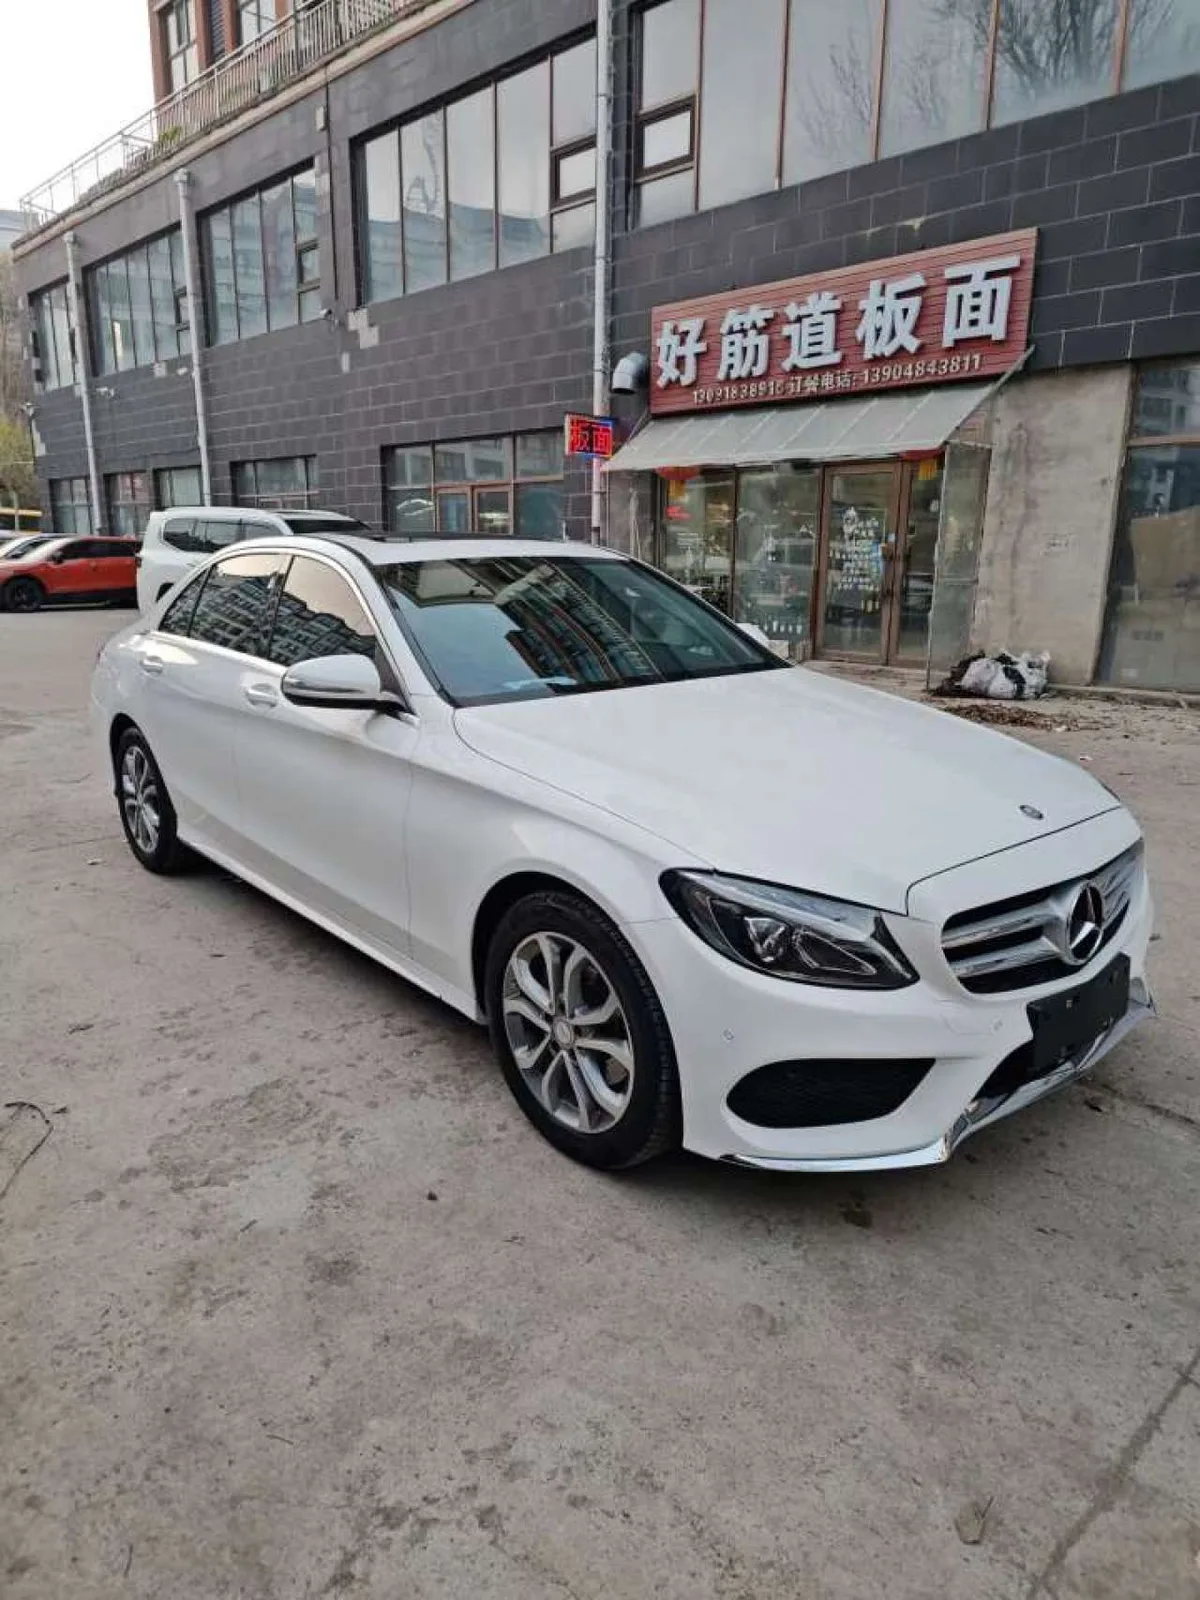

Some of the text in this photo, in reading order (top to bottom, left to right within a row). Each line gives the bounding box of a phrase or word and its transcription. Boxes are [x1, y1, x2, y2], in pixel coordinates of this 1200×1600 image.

[656, 254, 1021, 389] 好筋道板面
[862, 353, 982, 385] 13904843811
[569, 418, 612, 455] 板面
